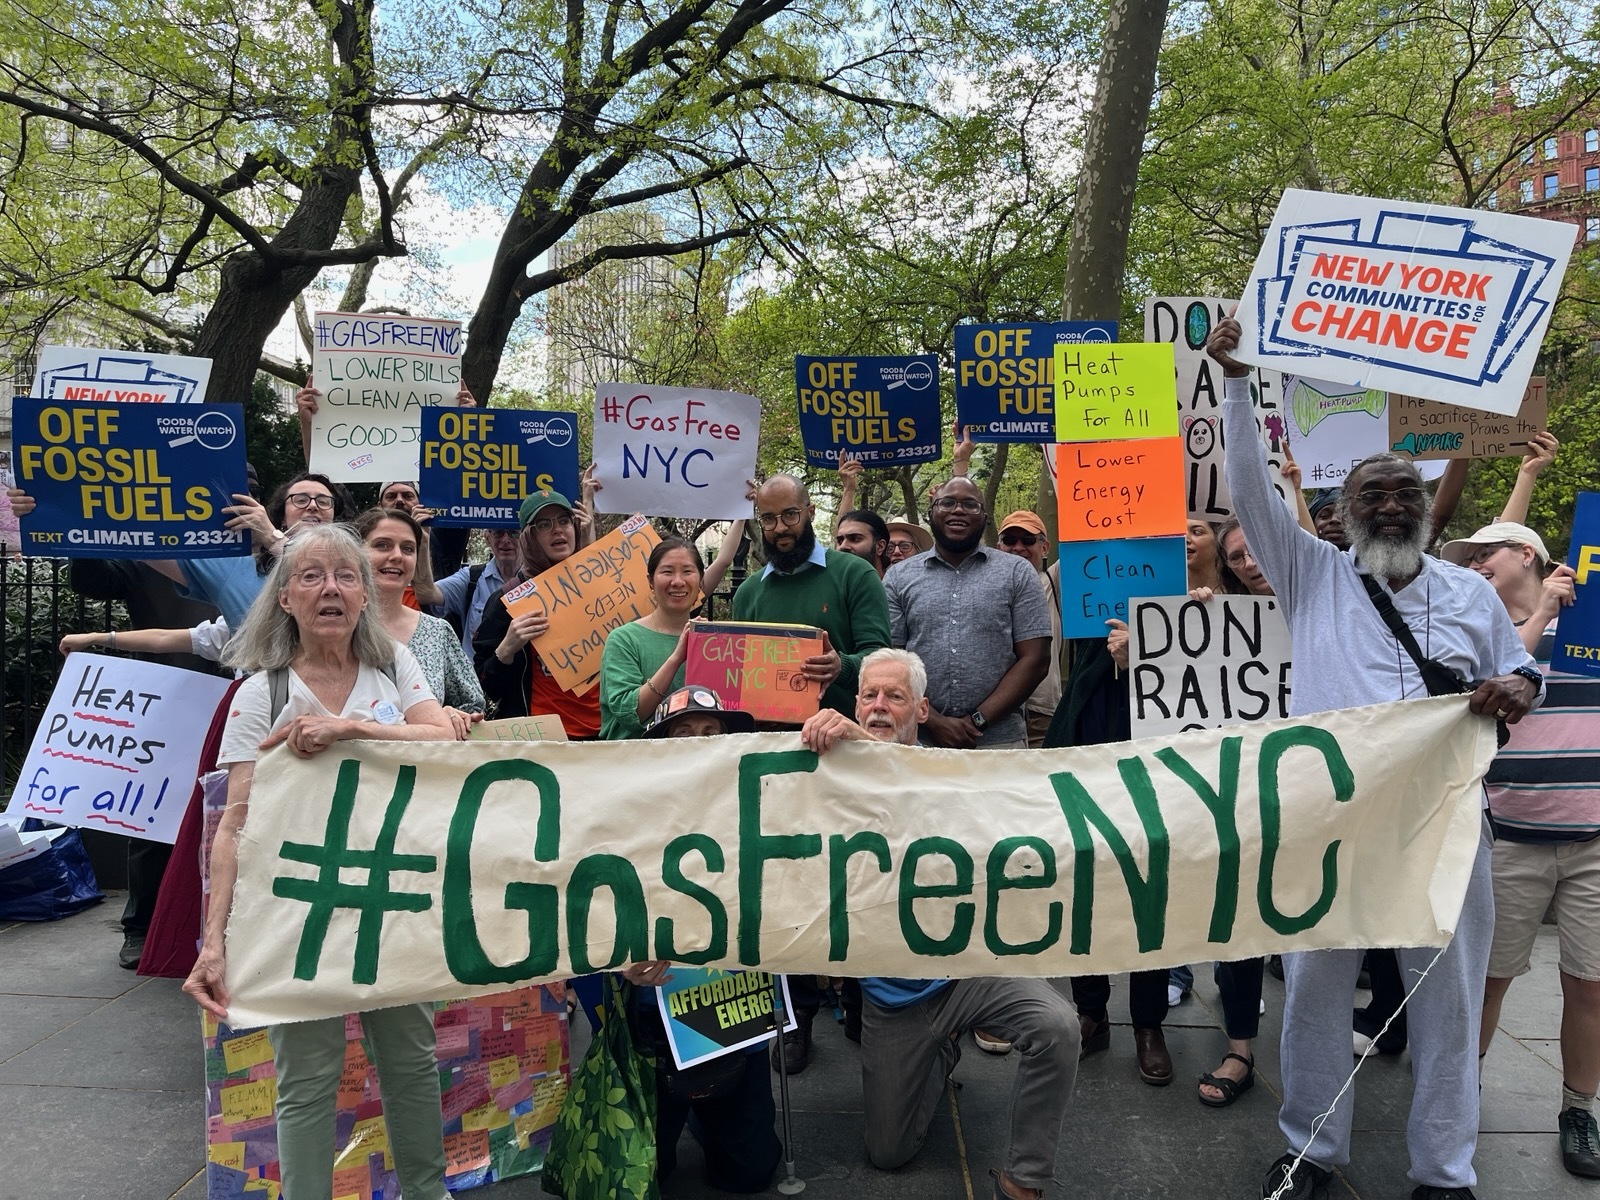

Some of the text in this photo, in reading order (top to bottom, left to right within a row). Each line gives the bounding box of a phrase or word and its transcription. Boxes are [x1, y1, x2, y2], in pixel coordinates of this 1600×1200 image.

[1311, 252, 1493, 302] NEW YORK
[1306, 281, 1487, 323] COMMUNITIES FOR
[315, 320, 461, 355] #GASFREENYC
[975, 329, 1031, 358] OFF
[1291, 300, 1477, 360] CHANGE
[329, 357, 461, 384] LOWER BILLS
[808, 361, 857, 389] OFF
[1064, 351, 1124, 376] Heat
[64, 386, 167, 404] NEW YORK
[327, 387, 443, 412] CLEAN AIR
[800, 388, 889, 417] FOSSIL
[999, 387, 1054, 415] FUE
[1062, 379, 1135, 403] Pumps
[39, 407, 120, 445] OFF
[159, 426, 233, 435] WATER WATCH
[438, 412, 495, 441] OFF
[989, 421, 1049, 433] CLIMATE
[1083, 408, 1149, 427] For All
[1400, 416, 1408, 426] a
[1420, 407, 1477, 427] sacrifice
[1470, 419, 1537, 436] Draws the
[327, 423, 398, 448] GOOD
[546, 428, 570, 436] WATCH
[832, 417, 917, 445] FUELS
[1416, 432, 1464, 451] NYPIRG
[350, 455, 372, 468] NYCC
[424, 441, 527, 471] FOSSIL
[808, 444, 937, 461] TEXT CLMATE TO 23321
[1077, 449, 1147, 468] Lower
[1471, 439, 1505, 457] Line
[20, 445, 171, 484] FOSSIL
[623, 443, 714, 488] NYC
[462, 472, 554, 500] FUELS
[1073, 480, 1145, 505] Energy
[81, 485, 213, 521] FUELS
[450, 506, 513, 519] CLIMATE
[622, 516, 646, 531] NYCC
[1086, 508, 1136, 528] Cost
[29, 529, 243, 546] TEXT CLIMATE TO 23321
[1083, 555, 1155, 580] Clean
[507, 582, 532, 598] NYCC
[584, 581, 637, 622] NEEDS
[1083, 592, 1126, 619] Ene
[1137, 600, 1276, 660] DON'
[702, 636, 801, 664] GASFREE
[72, 665, 161, 716] HEAT
[725, 667, 767, 689] NYC
[46, 714, 165, 764] PUMPS
[28, 767, 169, 823] for all!
[273, 725, 1355, 985] #GasFreeNYC
